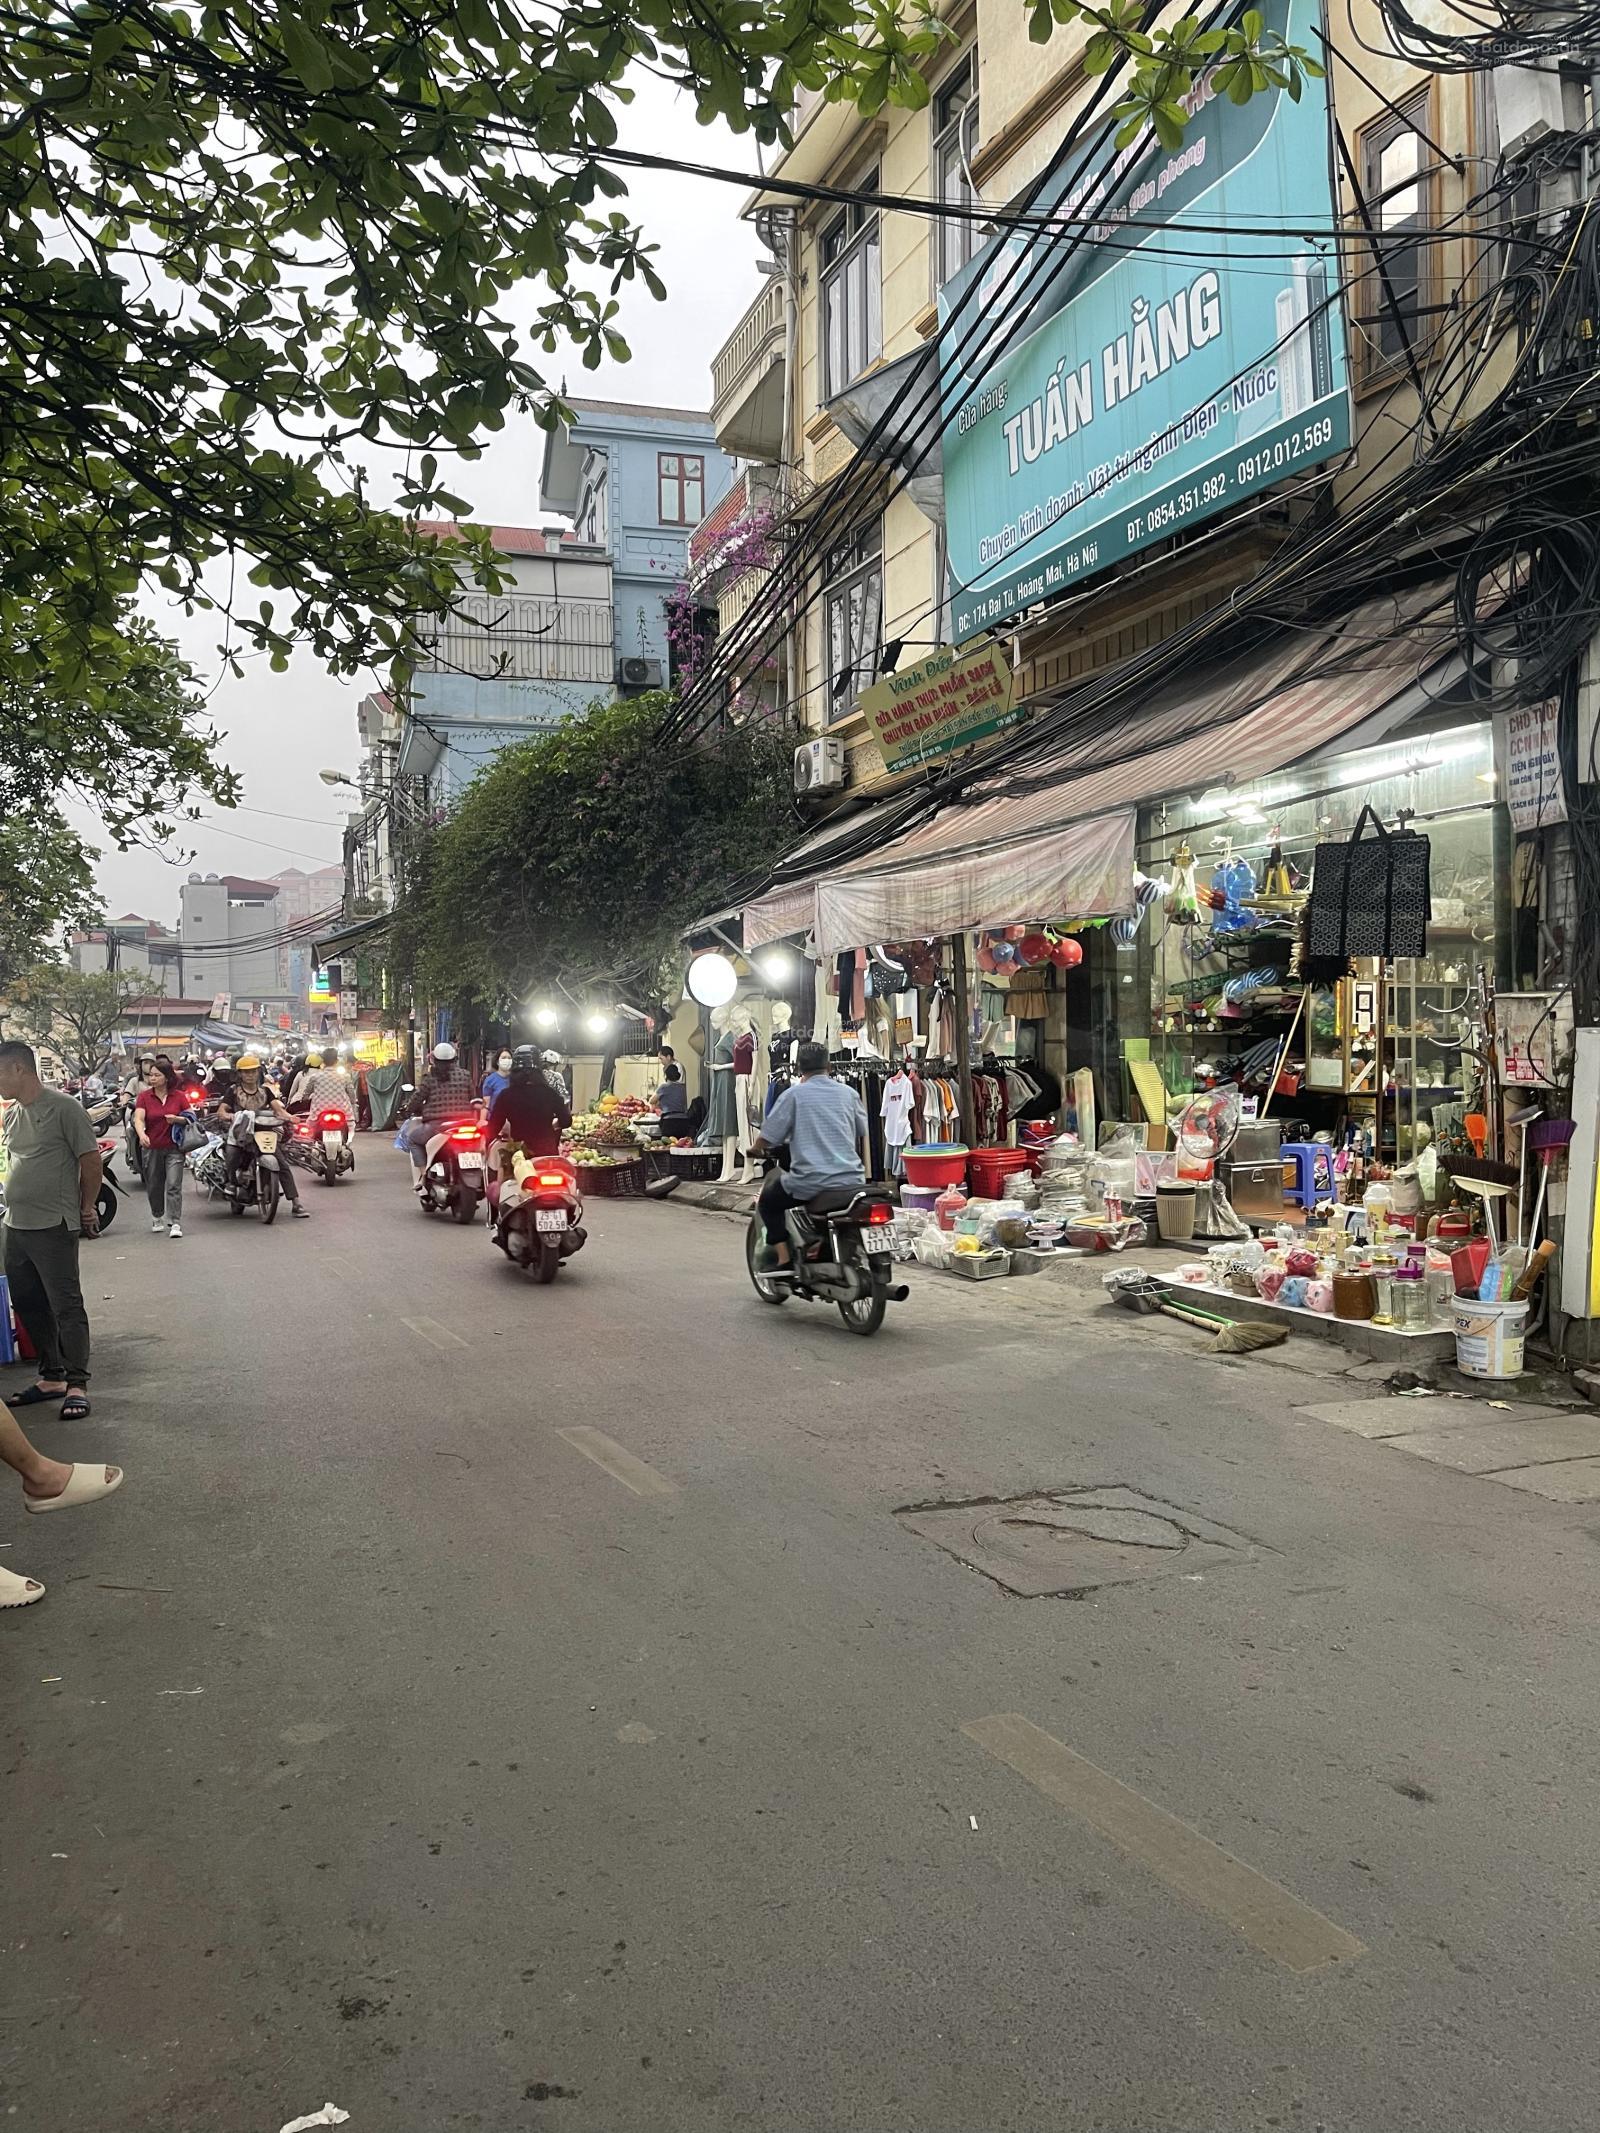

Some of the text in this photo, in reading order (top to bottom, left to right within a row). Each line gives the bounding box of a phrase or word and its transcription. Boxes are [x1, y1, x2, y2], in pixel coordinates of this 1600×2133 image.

[1157, 136, 1206, 198] phong
[1003, 355, 1094, 478] TUẤN
[1102, 269, 1222, 413] HẰNG
[958, 379, 1009, 435] Cửa hàng:
[980, 525, 1017, 564] Chuyên
[1018, 504, 1043, 538] kinh
[1046, 482, 1086, 523] doanh:
[1088, 465, 1112, 498] Vật
[1183, 401, 1218, 442] Điện
[1232, 366, 1278, 414] Nước
[1127, 517, 1144, 543] ĐT:
[1148, 472, 1226, 532] 0854.351.982
[1238, 417, 1332, 485] 0912.012.569
[973, 605, 987, 625] 174
[989, 596, 1001, 619] Đại
[1017, 575, 1044, 601] Hoàng
[1046, 561, 1065, 586] Mai,
[1067, 551, 1079, 574] Hà
[1082, 542, 1098, 567] Nội
[882, 721, 915, 745] CHUYÊN
[1509, 712, 1530, 734] CHO
[896, 1018, 911, 1027] SALE
